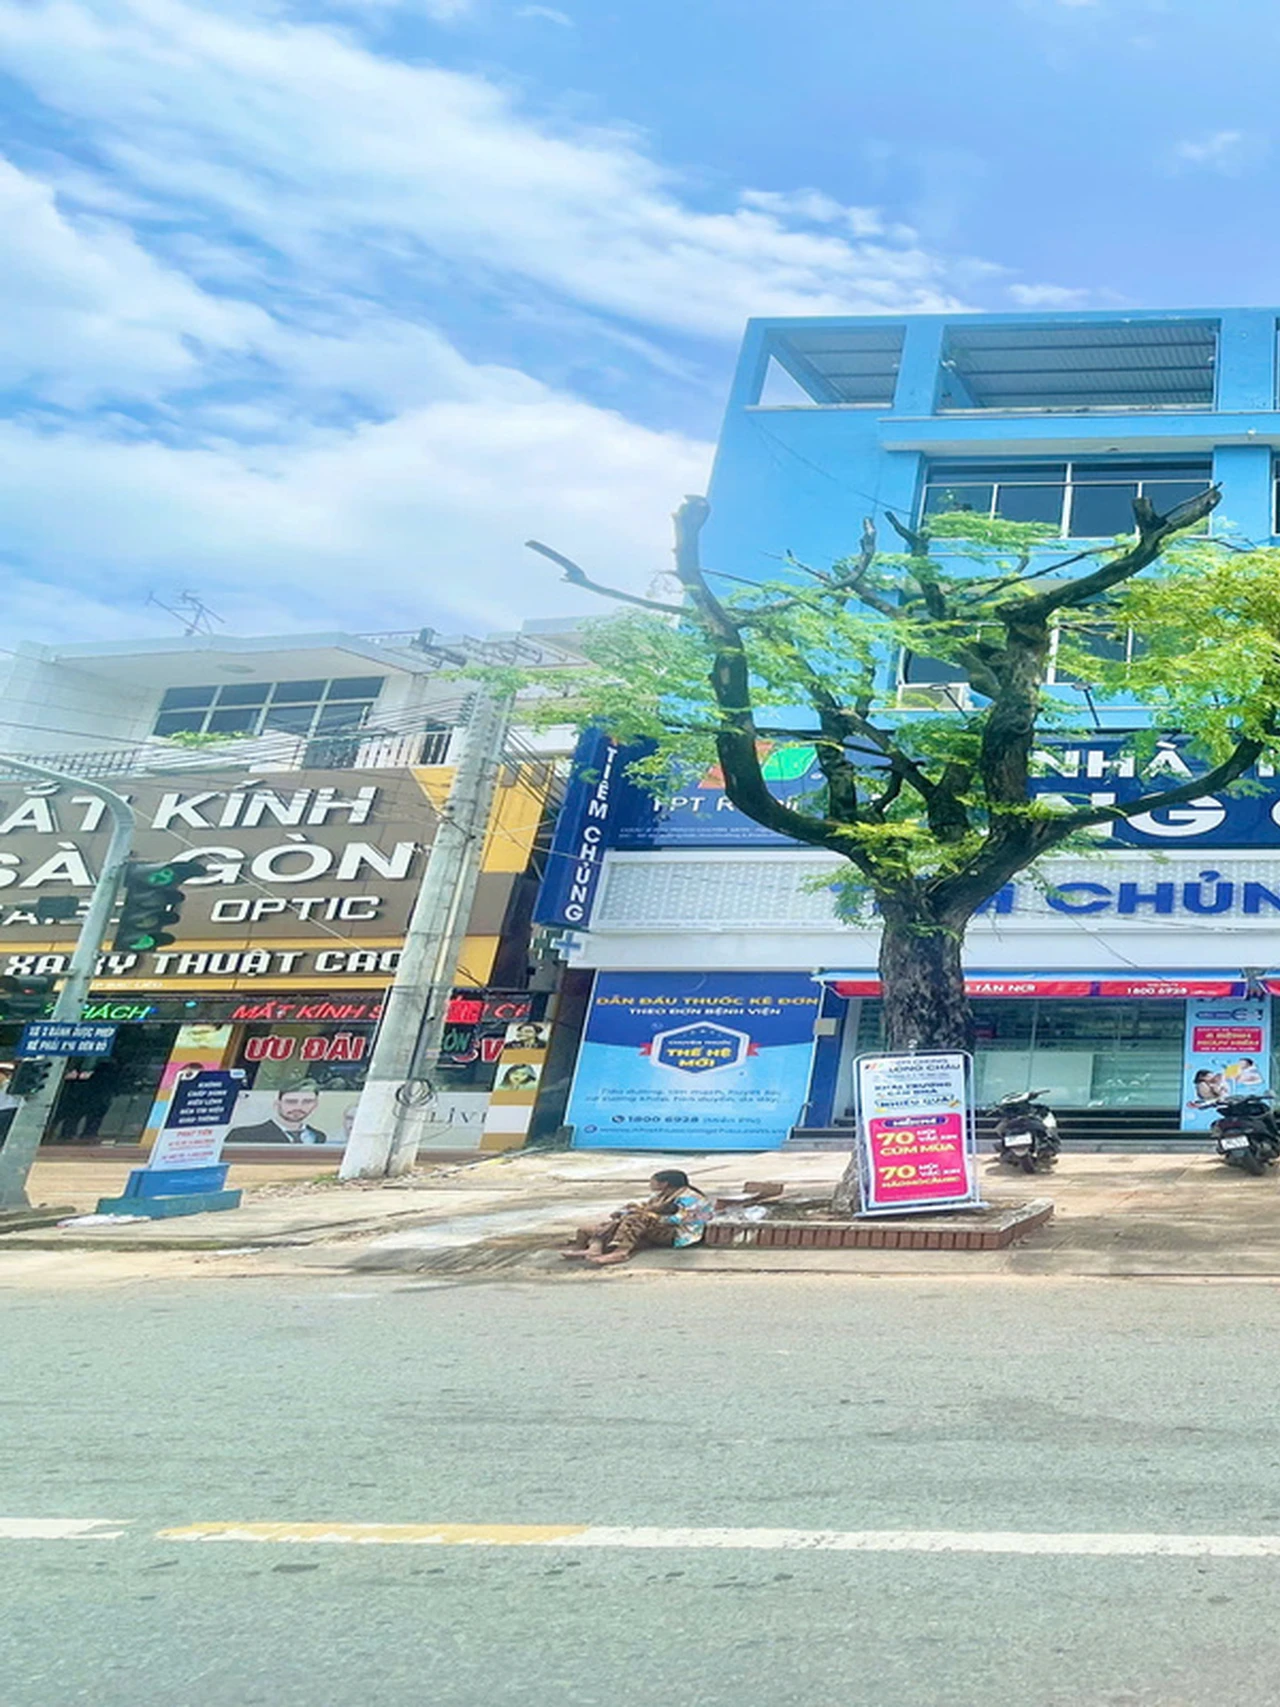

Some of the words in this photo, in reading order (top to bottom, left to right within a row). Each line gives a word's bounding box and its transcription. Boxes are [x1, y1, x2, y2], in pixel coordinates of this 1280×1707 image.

[1031, 741, 1193, 778] NHÀ
[597, 746, 618, 820] TIÊM
[151, 778, 378, 829] KÍNH
[0, 842, 98, 888] SÀ
[168, 833, 414, 886] GÒN
[210, 896, 380, 923] OPTIC
[152, 947, 303, 976] THUẬT
[315, 951, 402, 973] CAO
[232, 1000, 296, 1019] MẮT
[297, 1000, 366, 1019] KÍNH
[301, 1032, 365, 1061] ĐÃI
[628, 1115, 661, 1123] 1800
[876, 1131, 915, 1145] 70
[879, 1165, 916, 1179] 70
